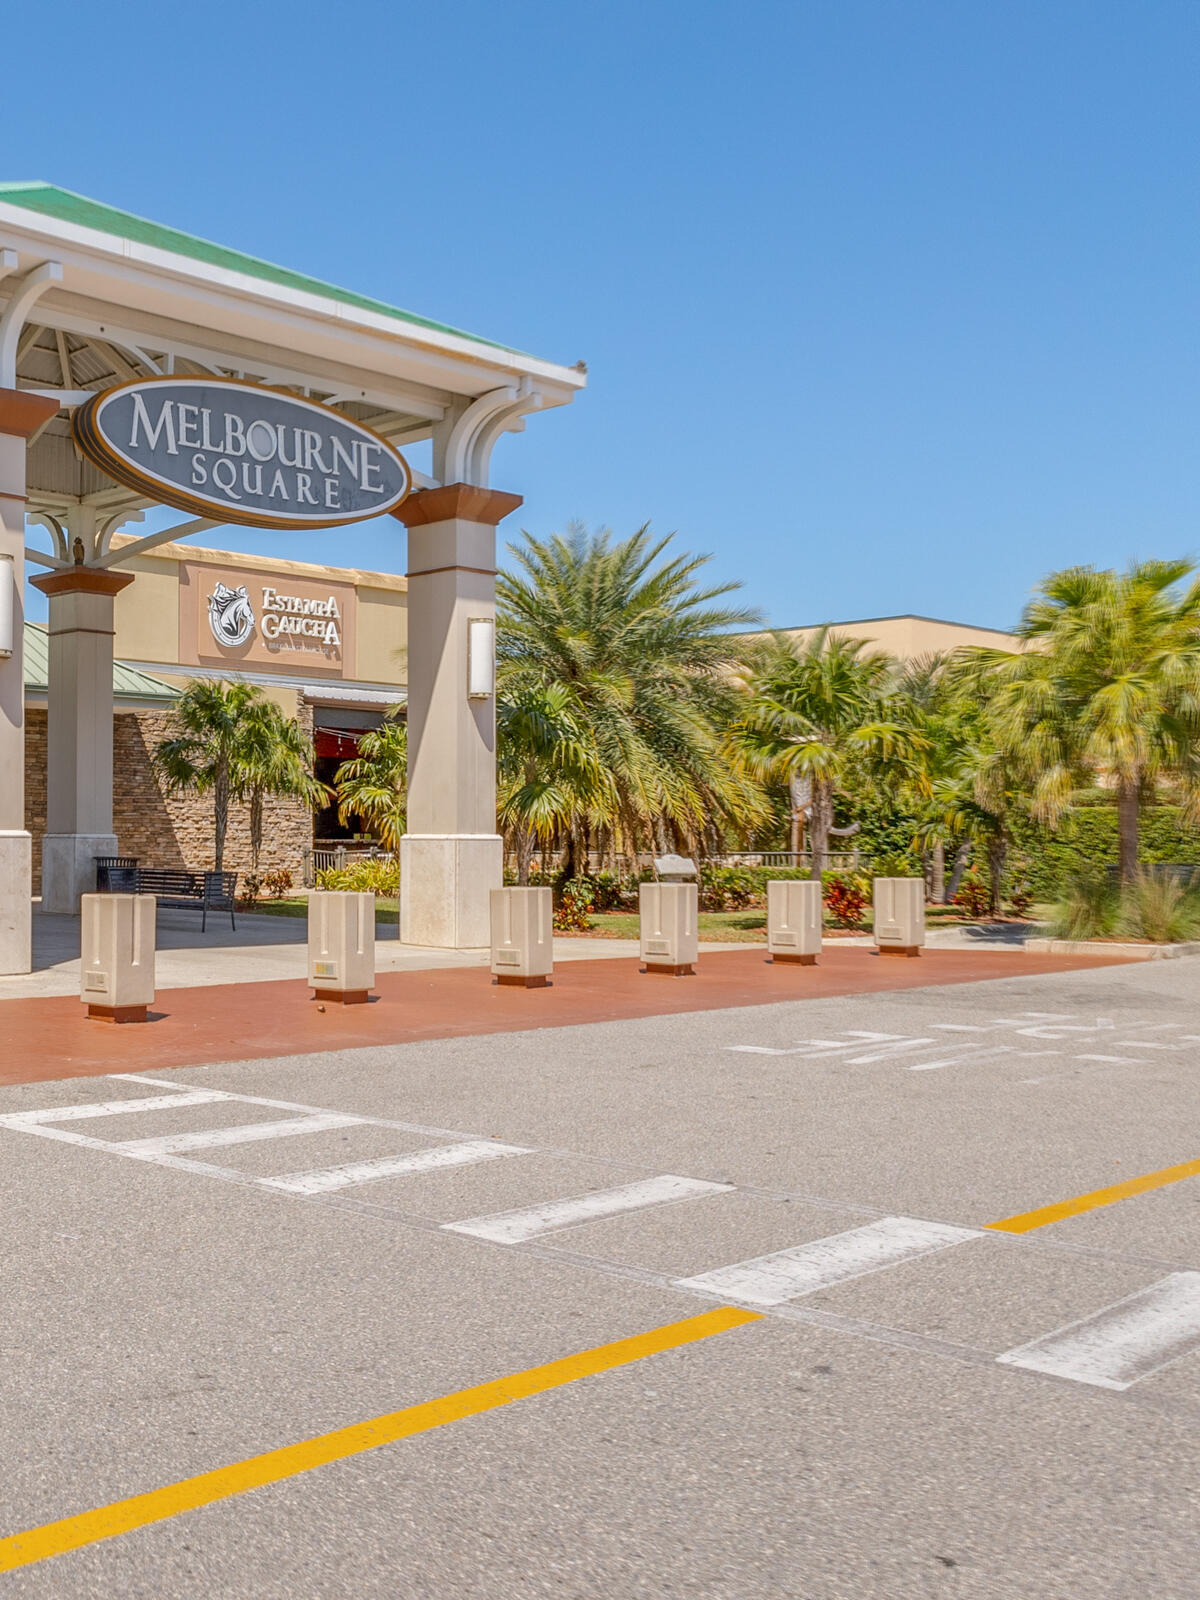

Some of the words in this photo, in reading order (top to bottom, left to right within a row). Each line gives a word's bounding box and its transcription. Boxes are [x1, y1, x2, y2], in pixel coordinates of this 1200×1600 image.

[128, 392, 384, 495] MELBOURNE
[191, 453, 341, 509] SQUARE
[261, 587, 341, 619] ESTAMPA
[261, 614, 341, 645] GAUCHA
